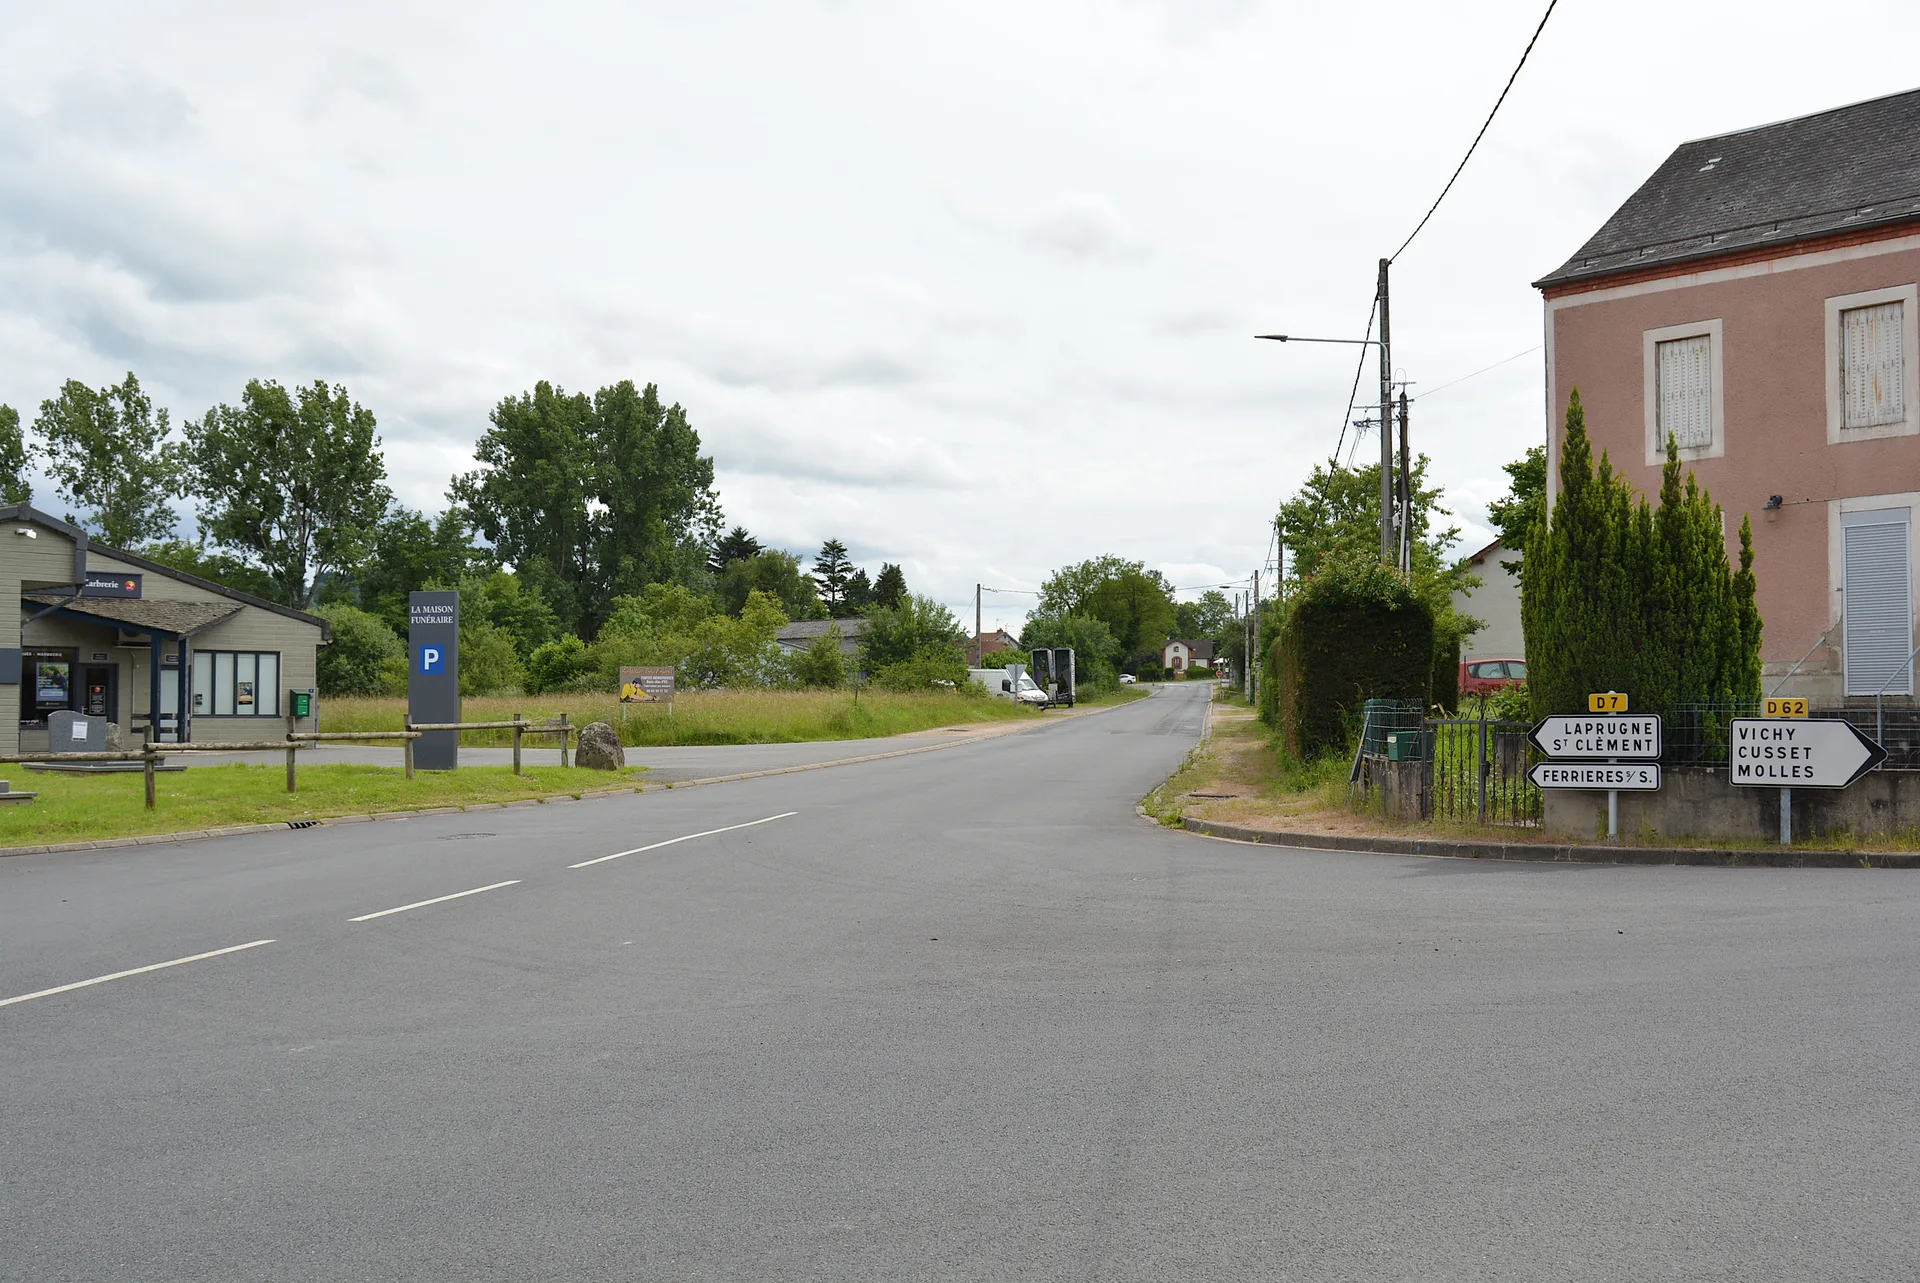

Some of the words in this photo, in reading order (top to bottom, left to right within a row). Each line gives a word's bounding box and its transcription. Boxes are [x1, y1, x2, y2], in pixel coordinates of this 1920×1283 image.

[423, 605, 453, 613] MAISON
[411, 614, 453, 623] FUNÉRAIRE
[424, 648, 439, 670] P
[1597, 697, 1605, 709] D
[1611, 697, 1618, 709] 7
[1768, 702, 1777, 713] D
[1782, 702, 1804, 714] 62
[1565, 723, 1652, 734] LAPRUGNE
[1738, 728, 1796, 740] VICHY
[1738, 746, 1812, 759] CUSSET
[1738, 764, 1814, 778] MOLLES
